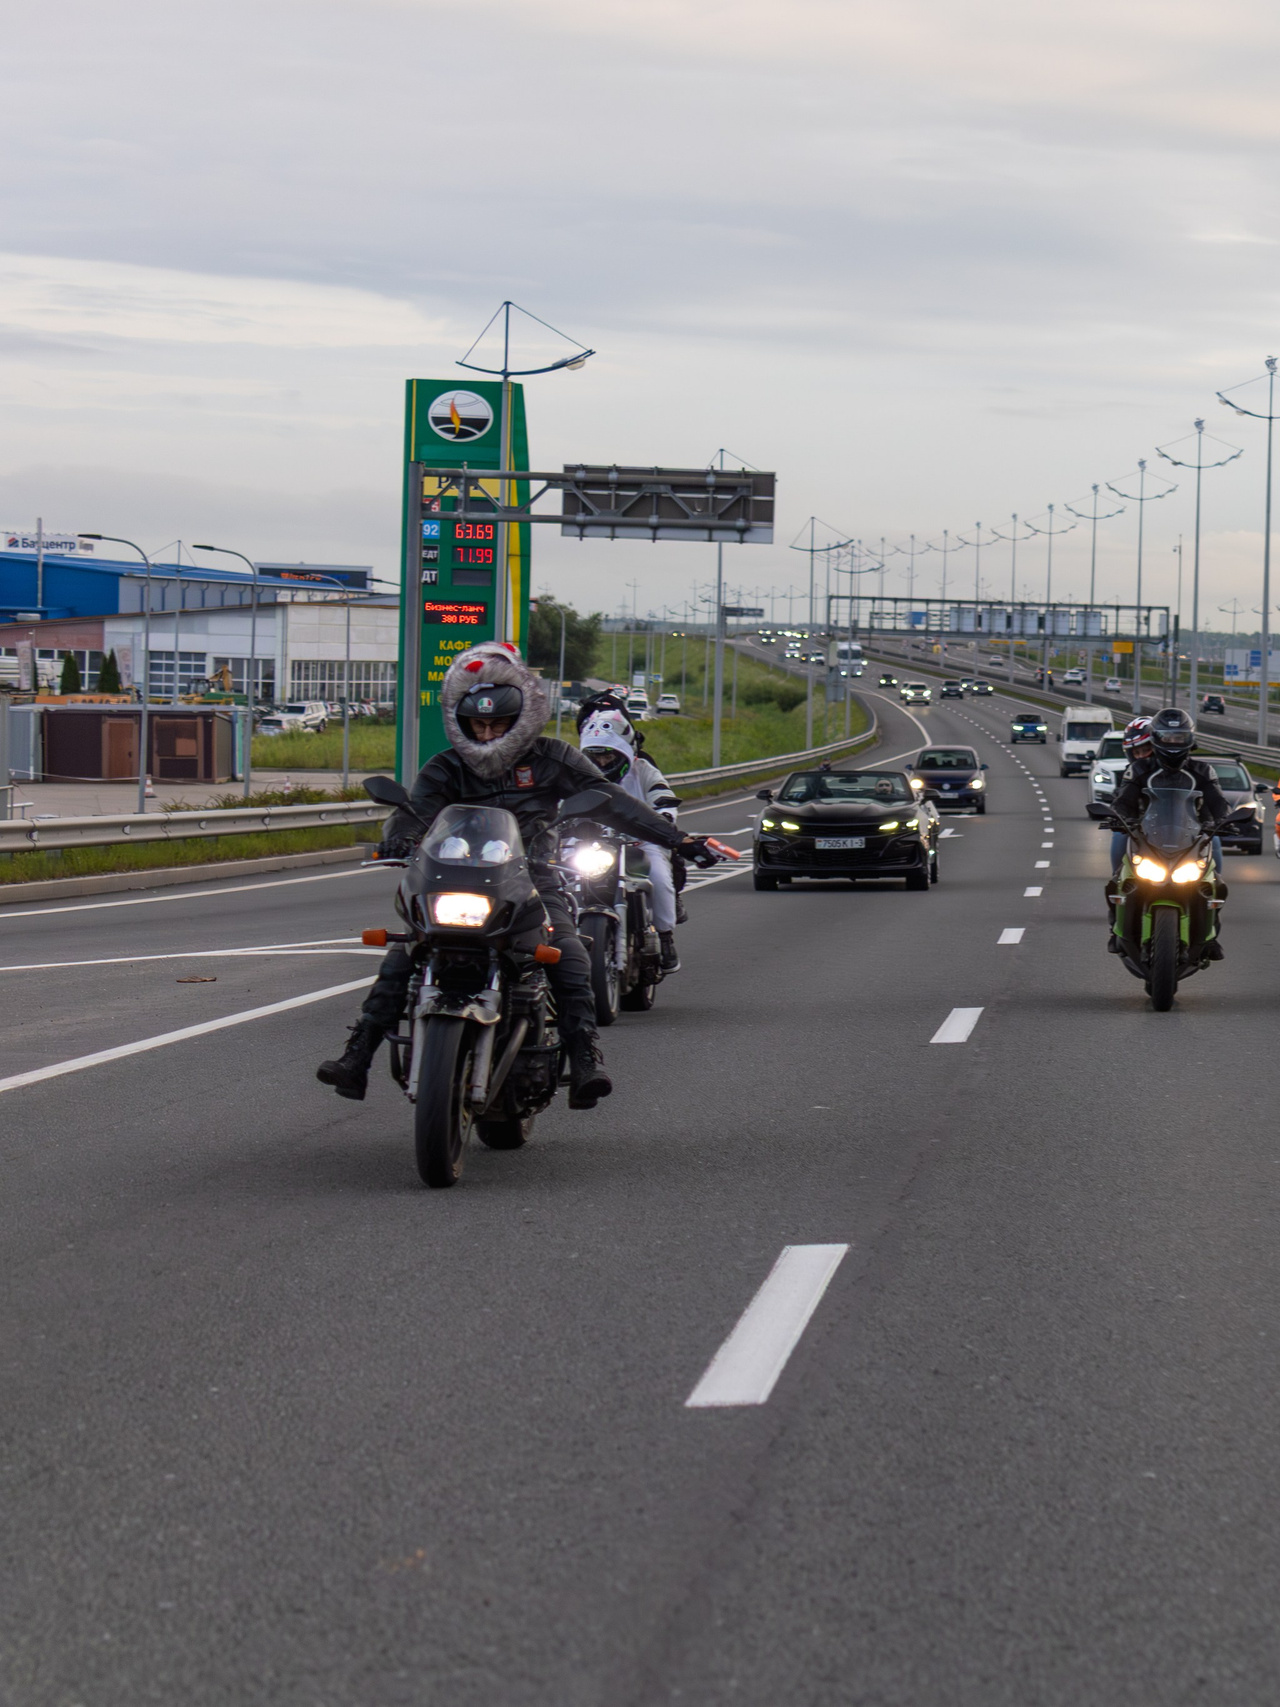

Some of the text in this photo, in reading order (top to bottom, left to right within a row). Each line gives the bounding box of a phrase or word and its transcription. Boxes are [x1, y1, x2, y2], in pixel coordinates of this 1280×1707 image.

[423, 523, 494, 540] 92 63.69
[456, 547, 493, 564] 71.99
[439, 640, 472, 651] КАФЕ
